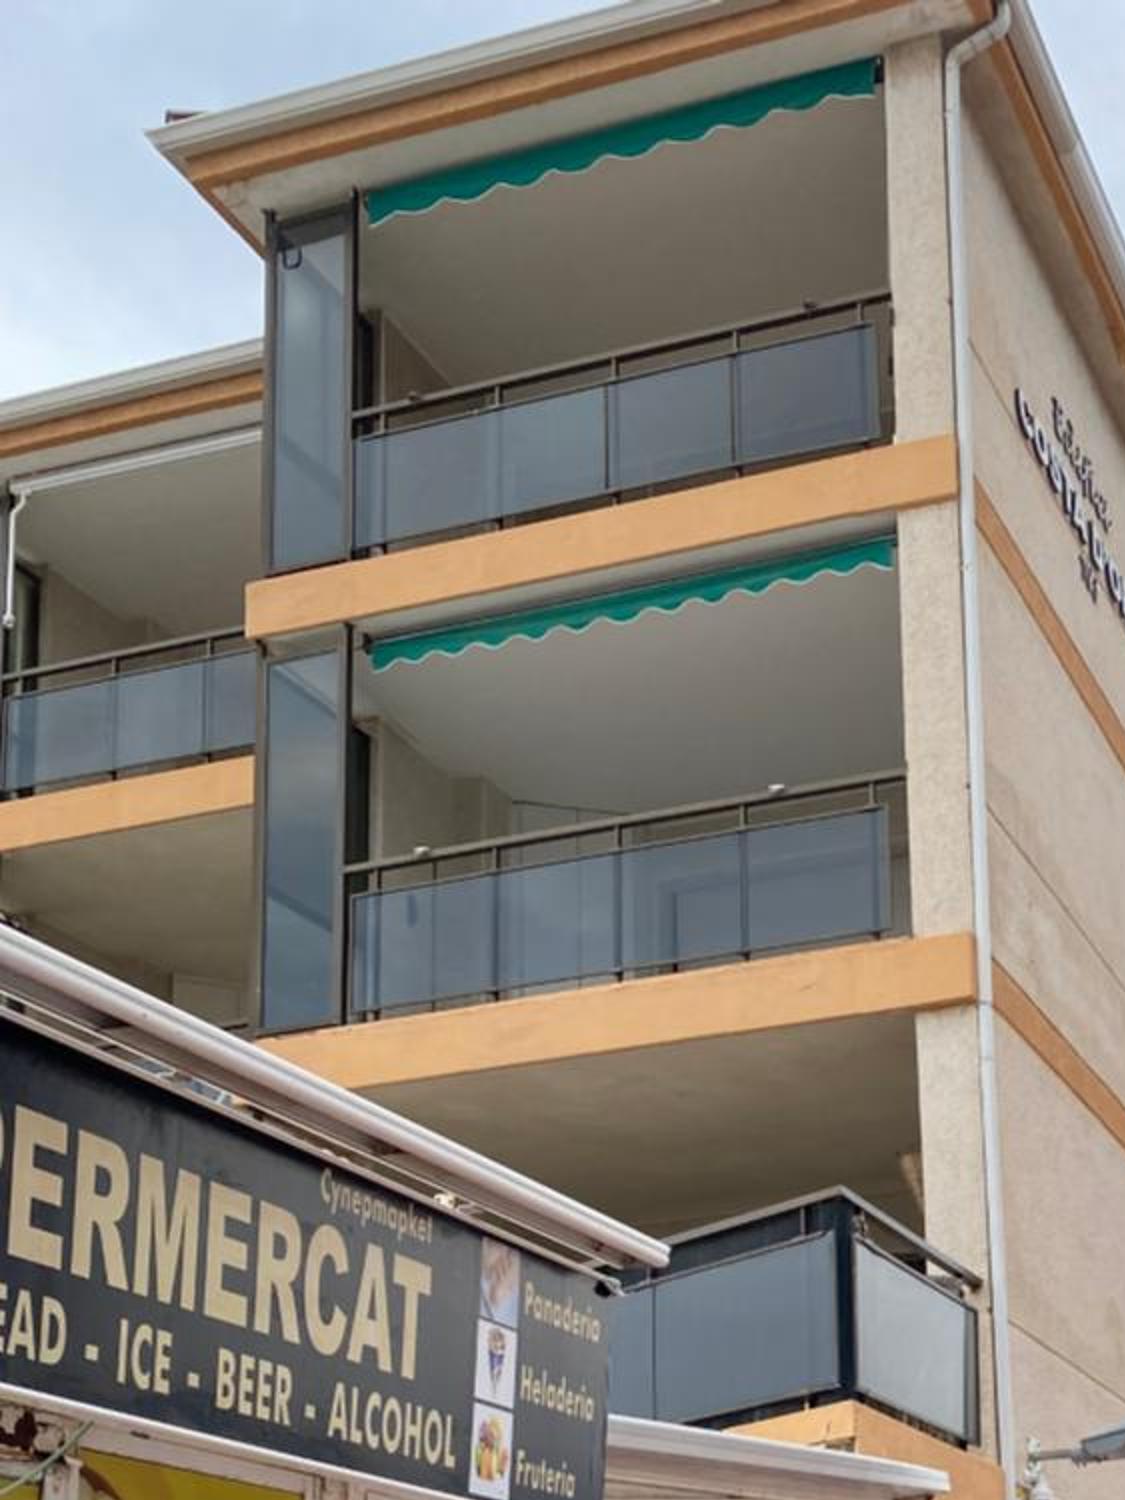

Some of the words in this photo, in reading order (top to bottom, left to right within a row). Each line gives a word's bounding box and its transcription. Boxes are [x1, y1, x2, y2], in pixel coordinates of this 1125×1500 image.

[0, 1102, 433, 1381] ERMERCAT
[117, 1317, 173, 1396] ICE
[215, 1347, 293, 1427] BEER
[328, 1381, 456, 1469] ALCOHOL
